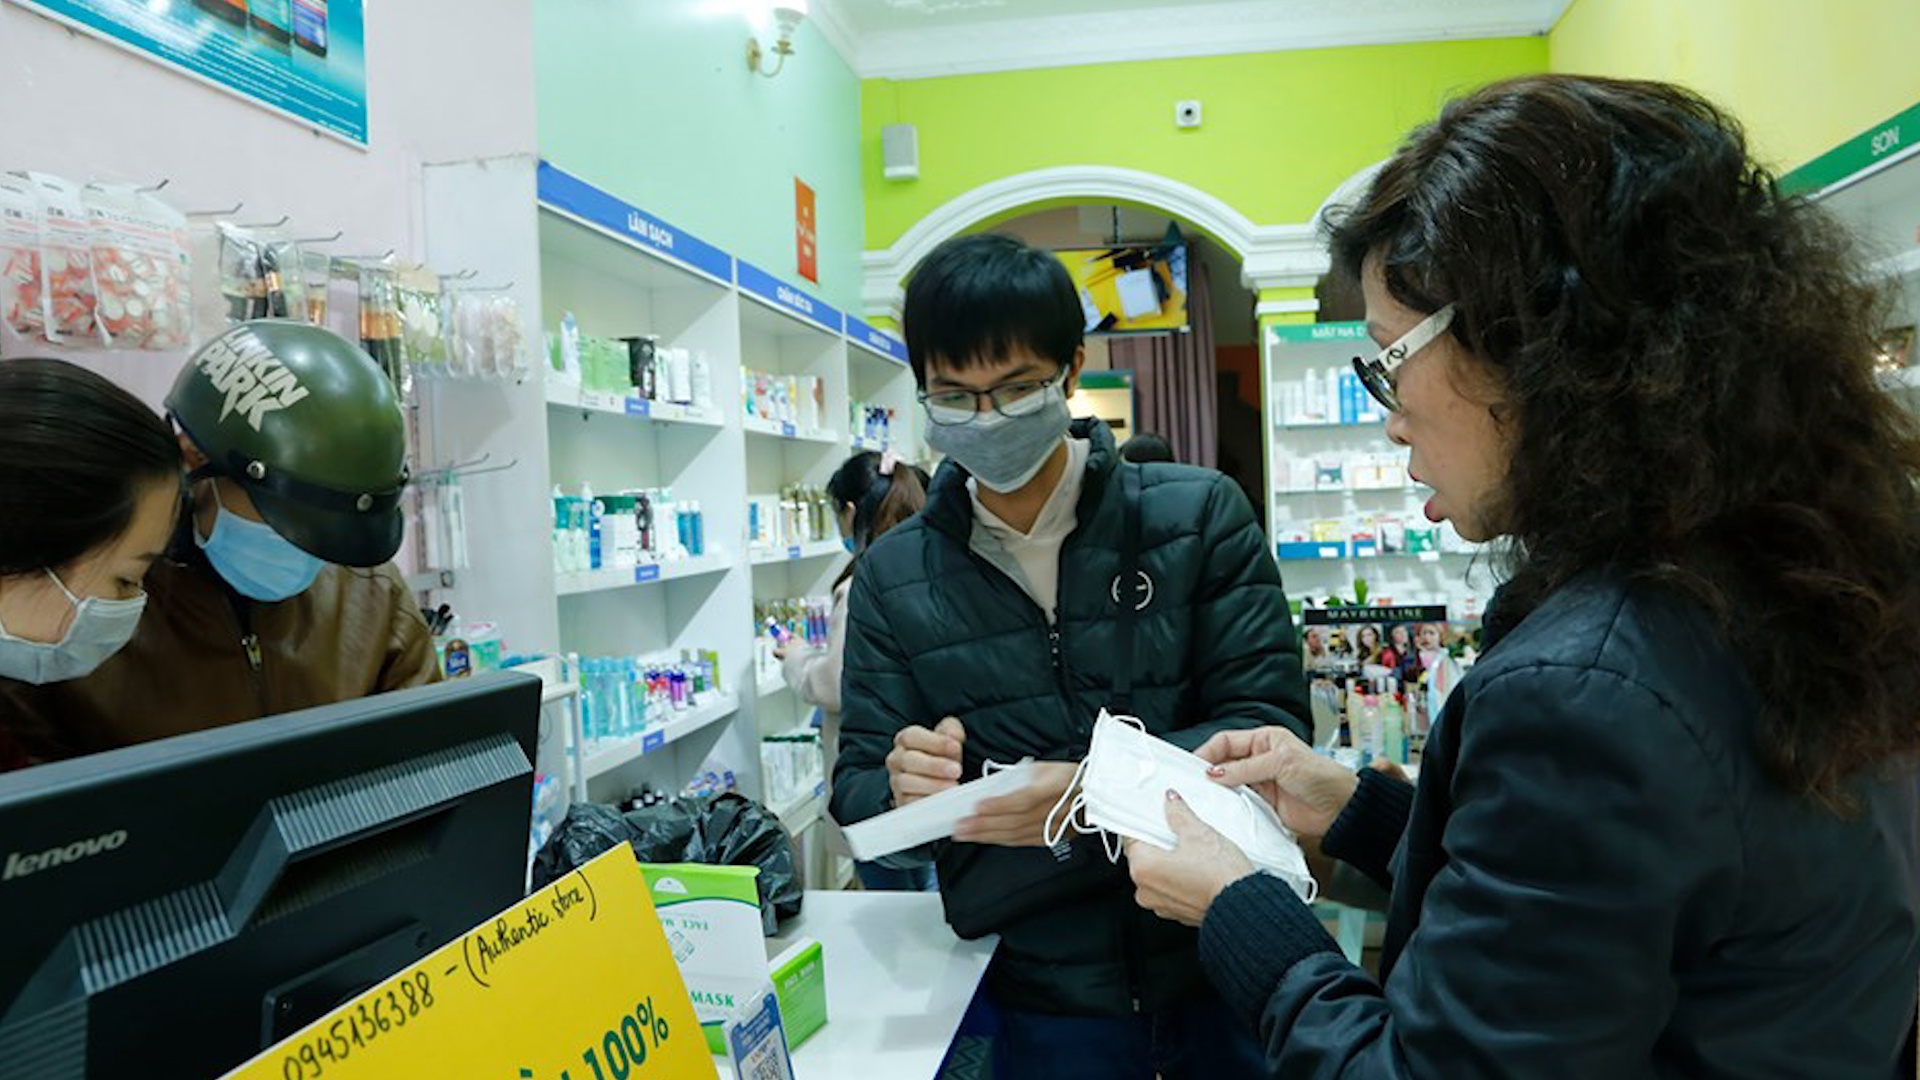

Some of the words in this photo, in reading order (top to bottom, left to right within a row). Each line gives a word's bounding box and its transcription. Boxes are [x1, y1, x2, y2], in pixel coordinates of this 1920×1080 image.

[628, 211, 649, 238] LÀM
[195, 339, 284, 433] PARK
[222, 326, 310, 408] LINKIN
[1326, 608, 1423, 619] MAYBELLINE
[2, 829, 129, 881] lenovo
[283, 971, 435, 1080] 0945136388
[691, 990, 735, 1008] MASK
[582, 996, 669, 1080] 100%
